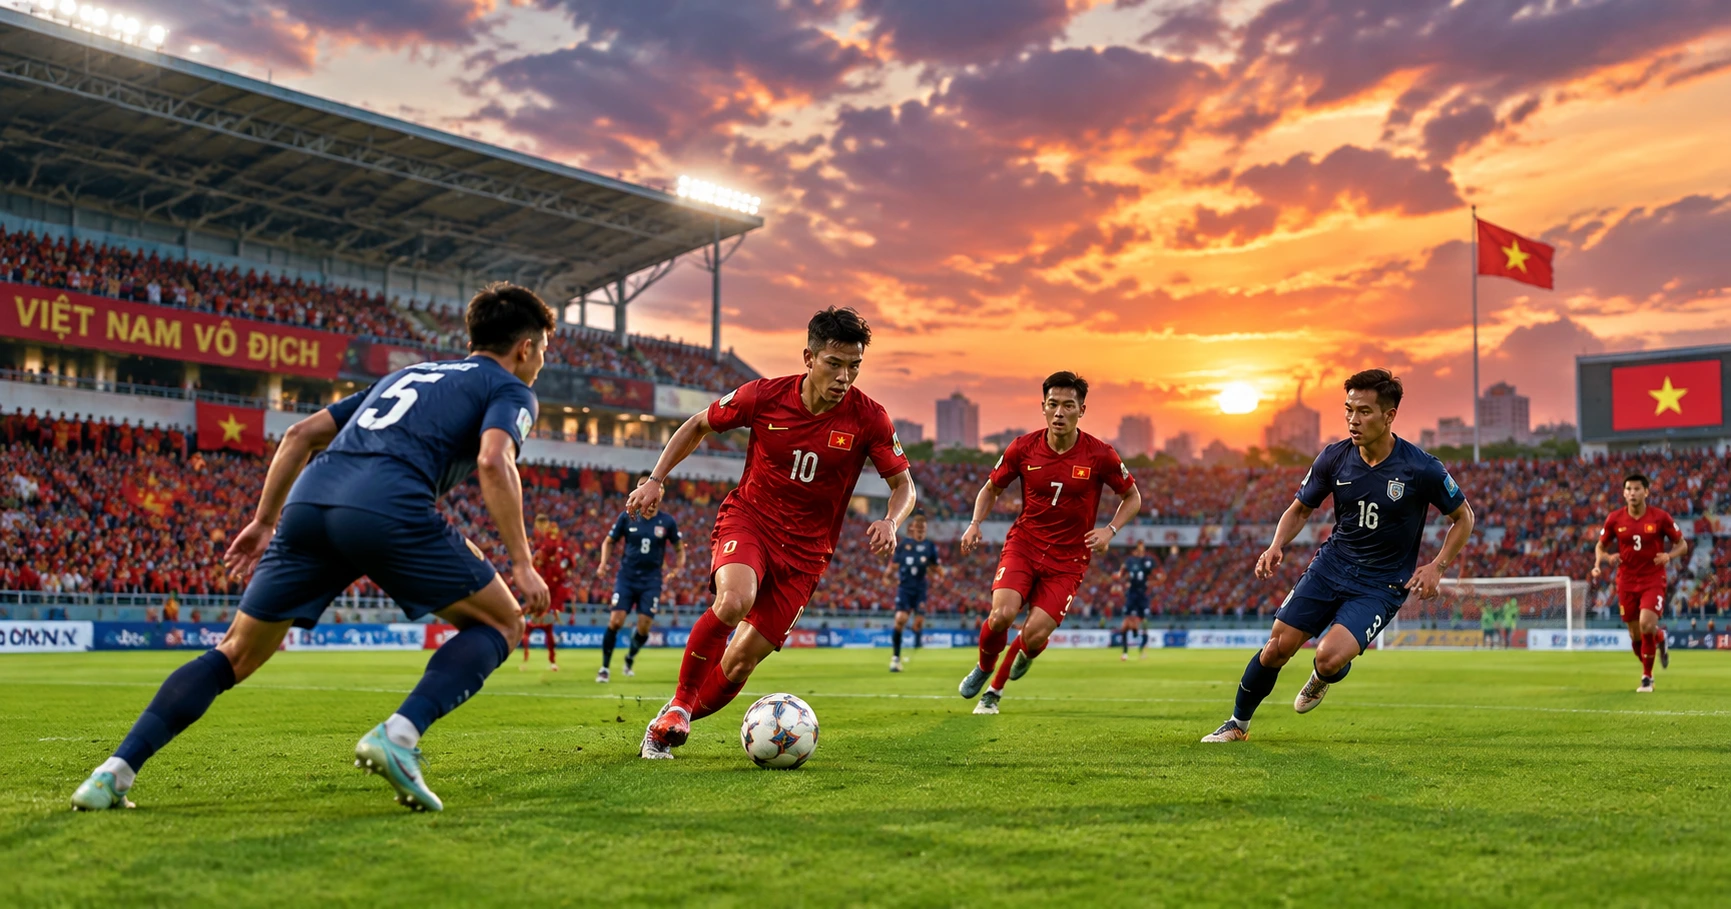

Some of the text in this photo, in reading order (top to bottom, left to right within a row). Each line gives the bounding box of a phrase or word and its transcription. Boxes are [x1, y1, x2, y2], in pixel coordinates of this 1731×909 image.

[14, 293, 320, 369] VIỆT NAM VÔ ĐỊCH
[357, 372, 445, 430] 5
[790, 449, 818, 483] 10
[1050, 481, 1063, 506] 7
[1358, 500, 1379, 530] 16
[641, 538, 651, 554] 8
[1632, 534, 1642, 551] 3
